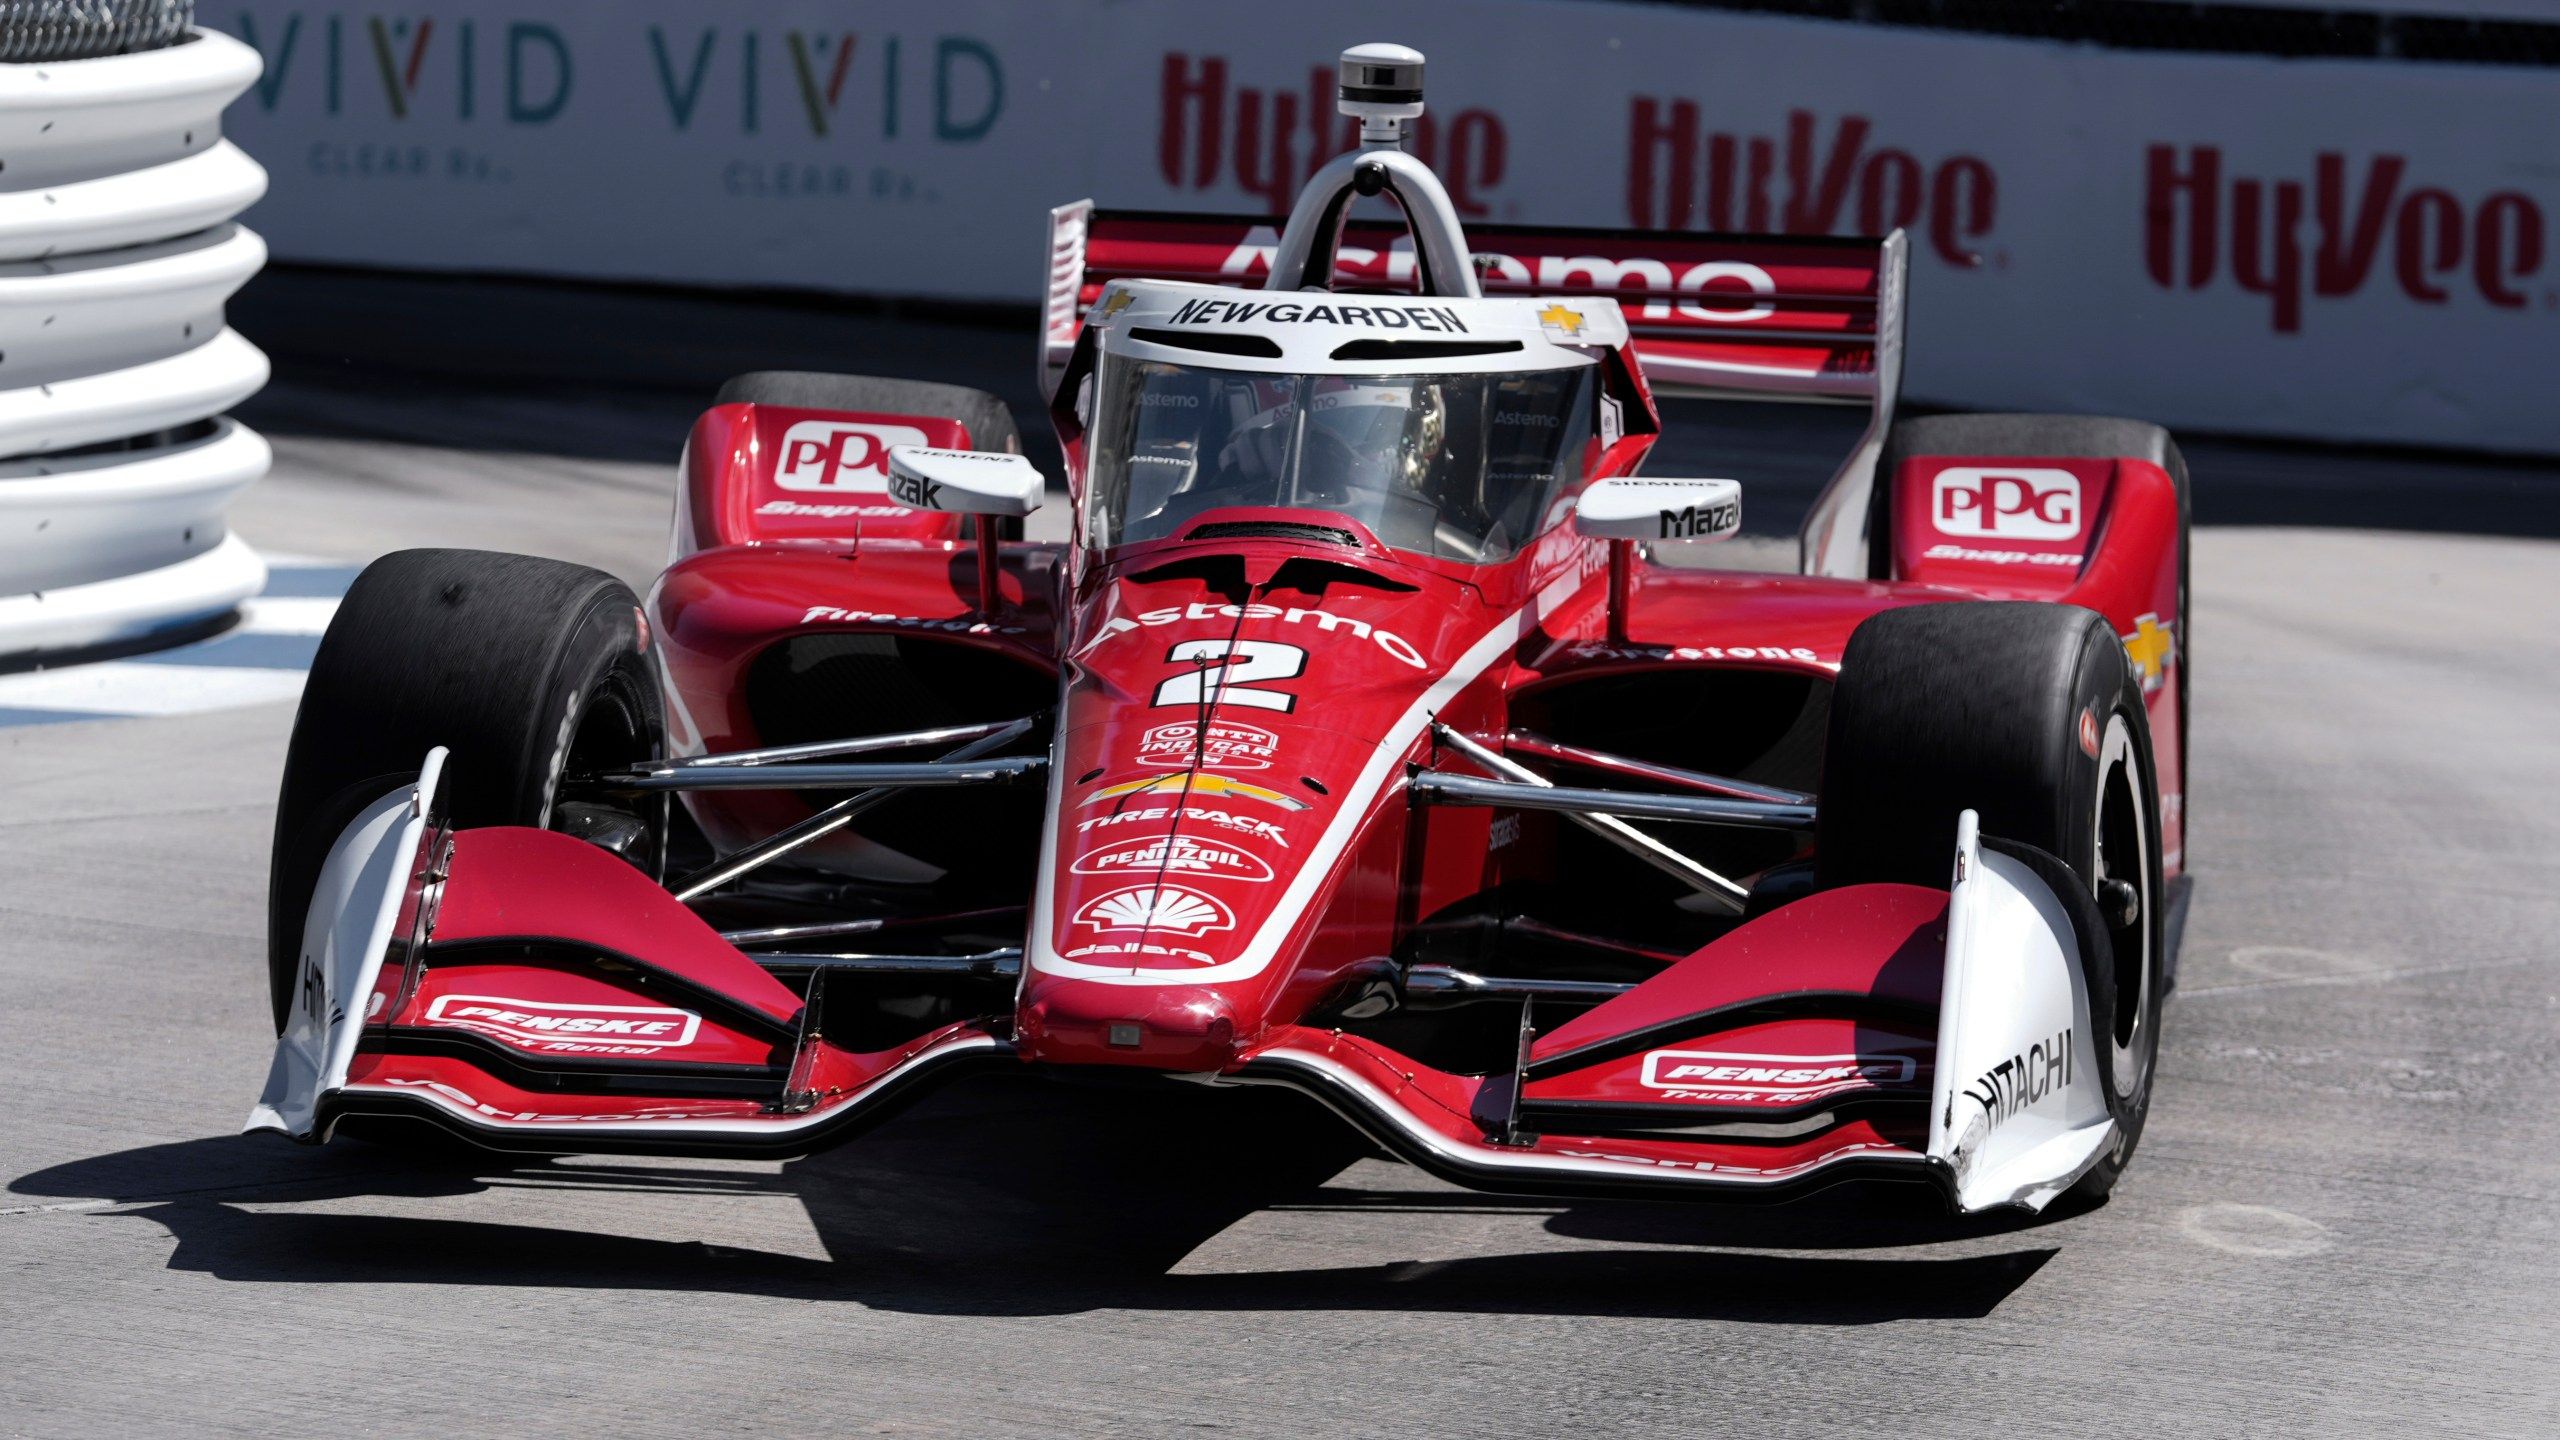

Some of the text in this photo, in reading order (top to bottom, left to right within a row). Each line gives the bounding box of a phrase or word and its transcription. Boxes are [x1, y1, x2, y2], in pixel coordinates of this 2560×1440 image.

[241, 12, 574, 124] VIVID
[649, 24, 1002, 142] VIVID
[2145, 143, 2542, 333] HyVee
[1168, 298, 1470, 334] NEWGARDEN
[1494, 410, 1559, 429] Astemo
[906, 448, 1016, 463] SIEMENS
[1606, 480, 1722, 488] SIEMENS
[754, 499, 914, 519] Snap-on
[1942, 476, 2073, 530] PPG
[1923, 545, 2084, 566] Snap-on
[1073, 601, 1428, 669] Astemo
[1148, 639, 1311, 714] 2
[1206, 727, 1267, 743] NTT
[1077, 807, 1290, 849] TIRE RACK
[1096, 846, 1245, 869] PENNZOIL
[1065, 942, 1216, 965] dallara
[450, 1005, 680, 1035] PENSKE
[1664, 1064, 1895, 1083] PENSKE
[1962, 1028, 2072, 1136] HITACHI
[1660, 1089, 1761, 1102] Truck
